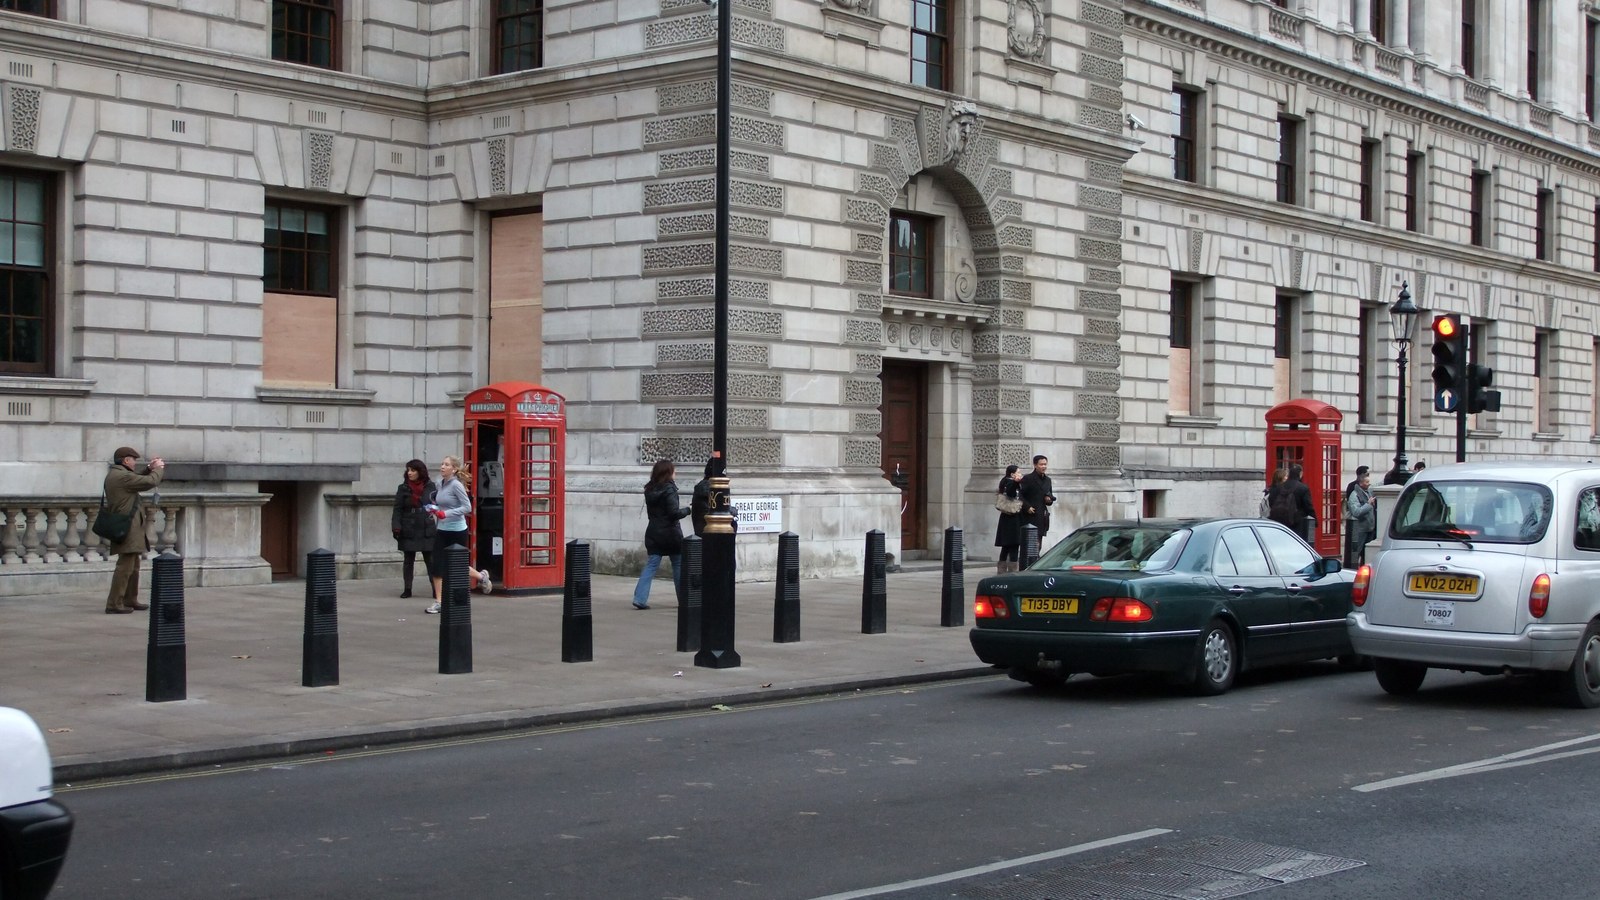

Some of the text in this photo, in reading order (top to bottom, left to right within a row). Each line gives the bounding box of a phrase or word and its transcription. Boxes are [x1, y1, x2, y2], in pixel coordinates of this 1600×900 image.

[735, 502, 778, 511] GREAT GEORGE
[735, 513, 771, 522] STREET SW1
[1415, 577, 1473, 592] LV02 OZH
[1028, 599, 1073, 611] T135 DBY
[1427, 609, 1452, 618] 70807
